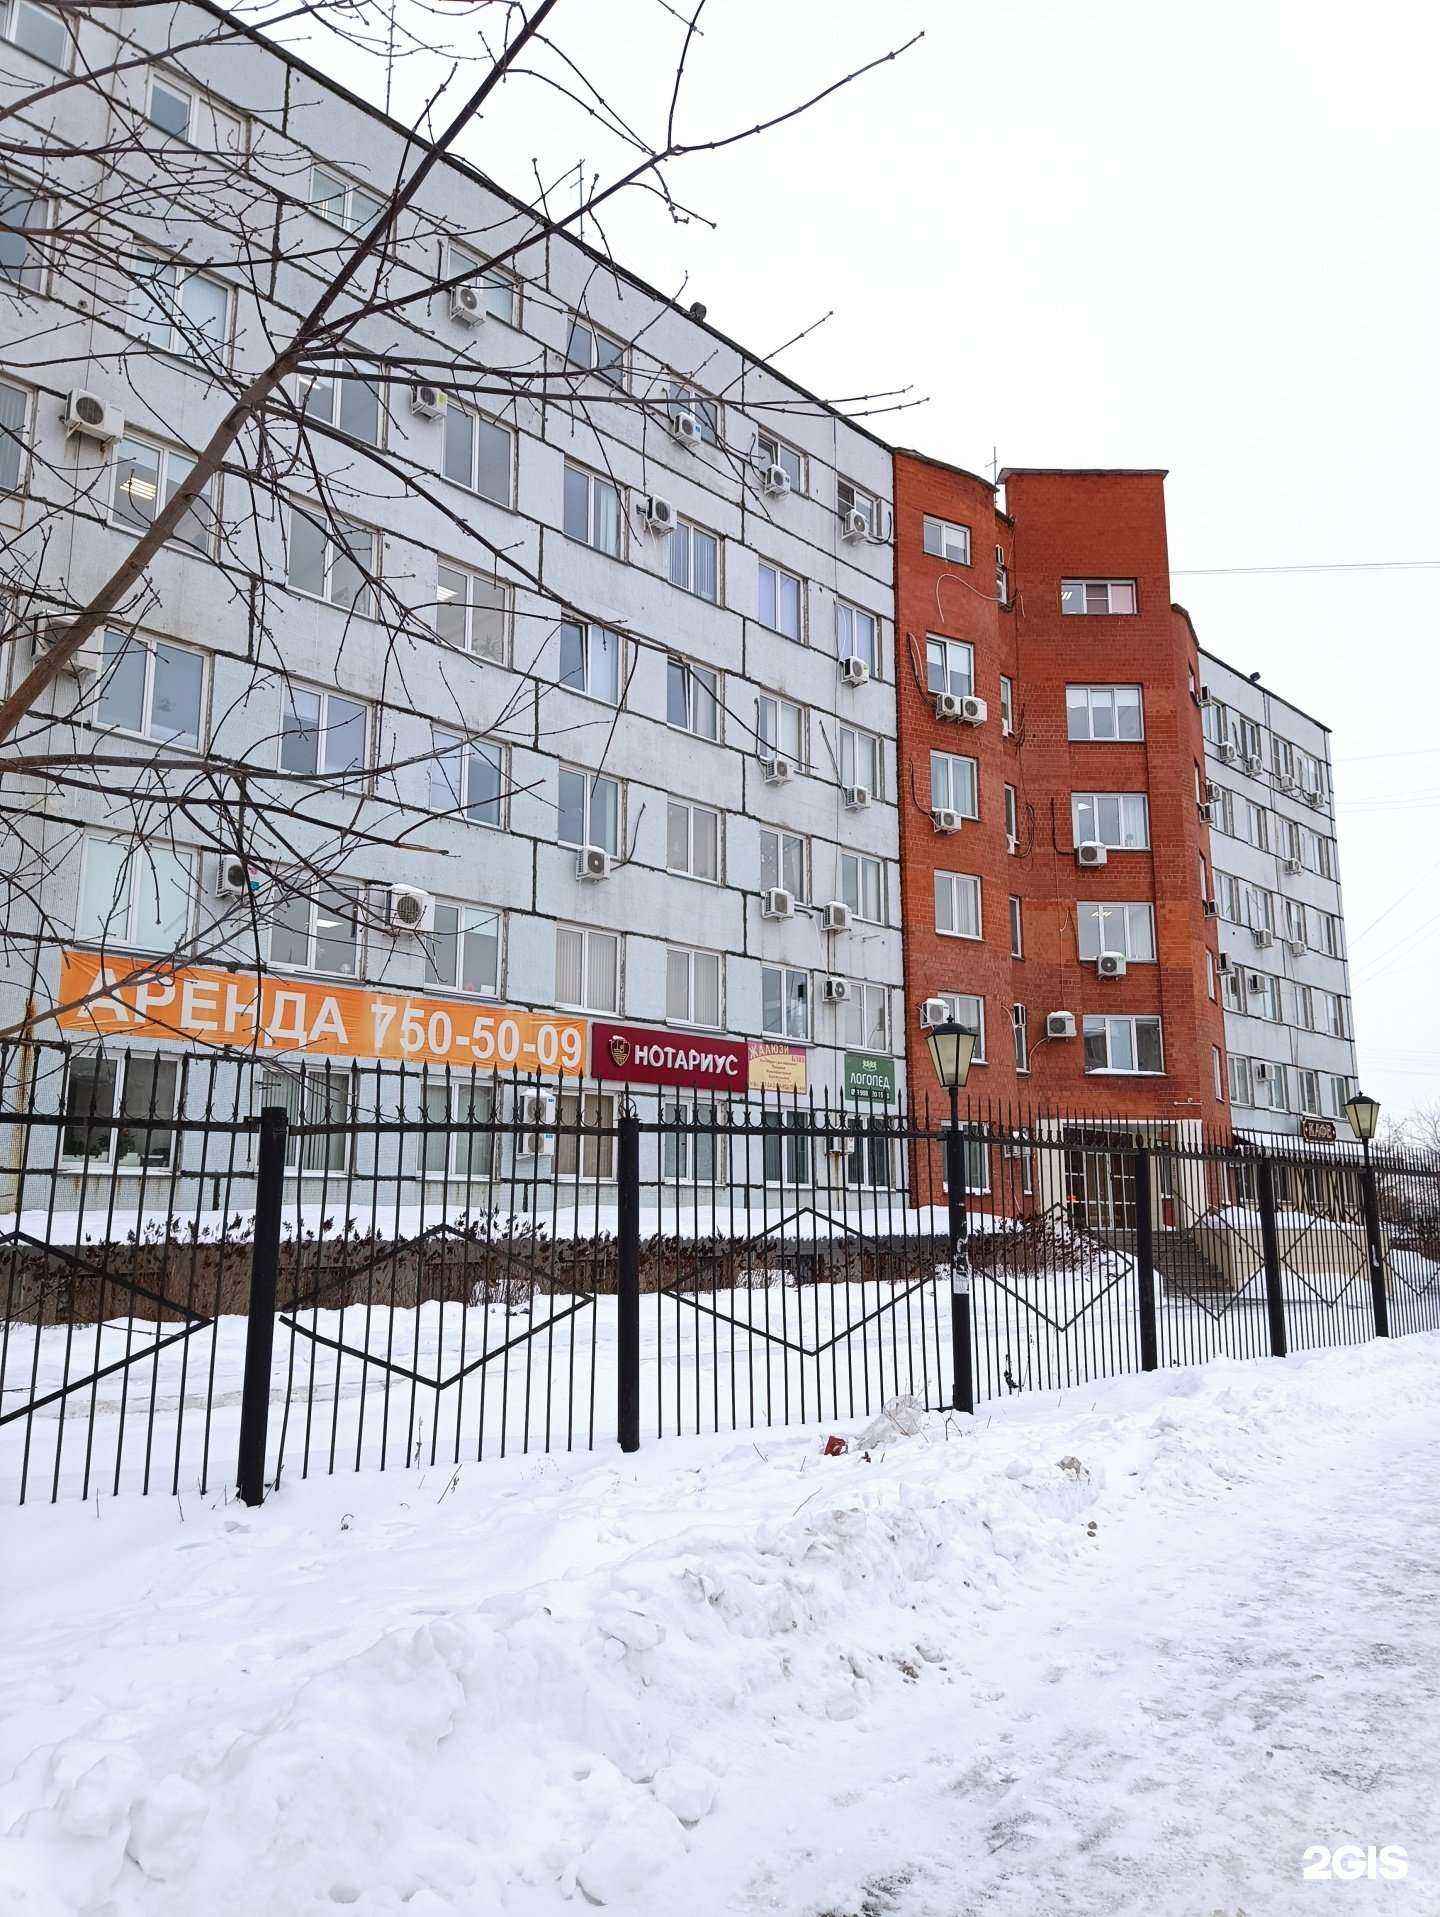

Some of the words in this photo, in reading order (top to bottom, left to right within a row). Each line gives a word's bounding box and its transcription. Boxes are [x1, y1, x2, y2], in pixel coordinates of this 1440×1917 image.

[77, 967, 349, 1047] АРЕНДА
[371, 1003, 582, 1068] 750-50-09
[634, 1044, 739, 1076] НОТАРИУС
[748, 1043, 790, 1060] ЖАЛЮЗИ
[850, 1072, 891, 1090] ЛОГОПЕД
